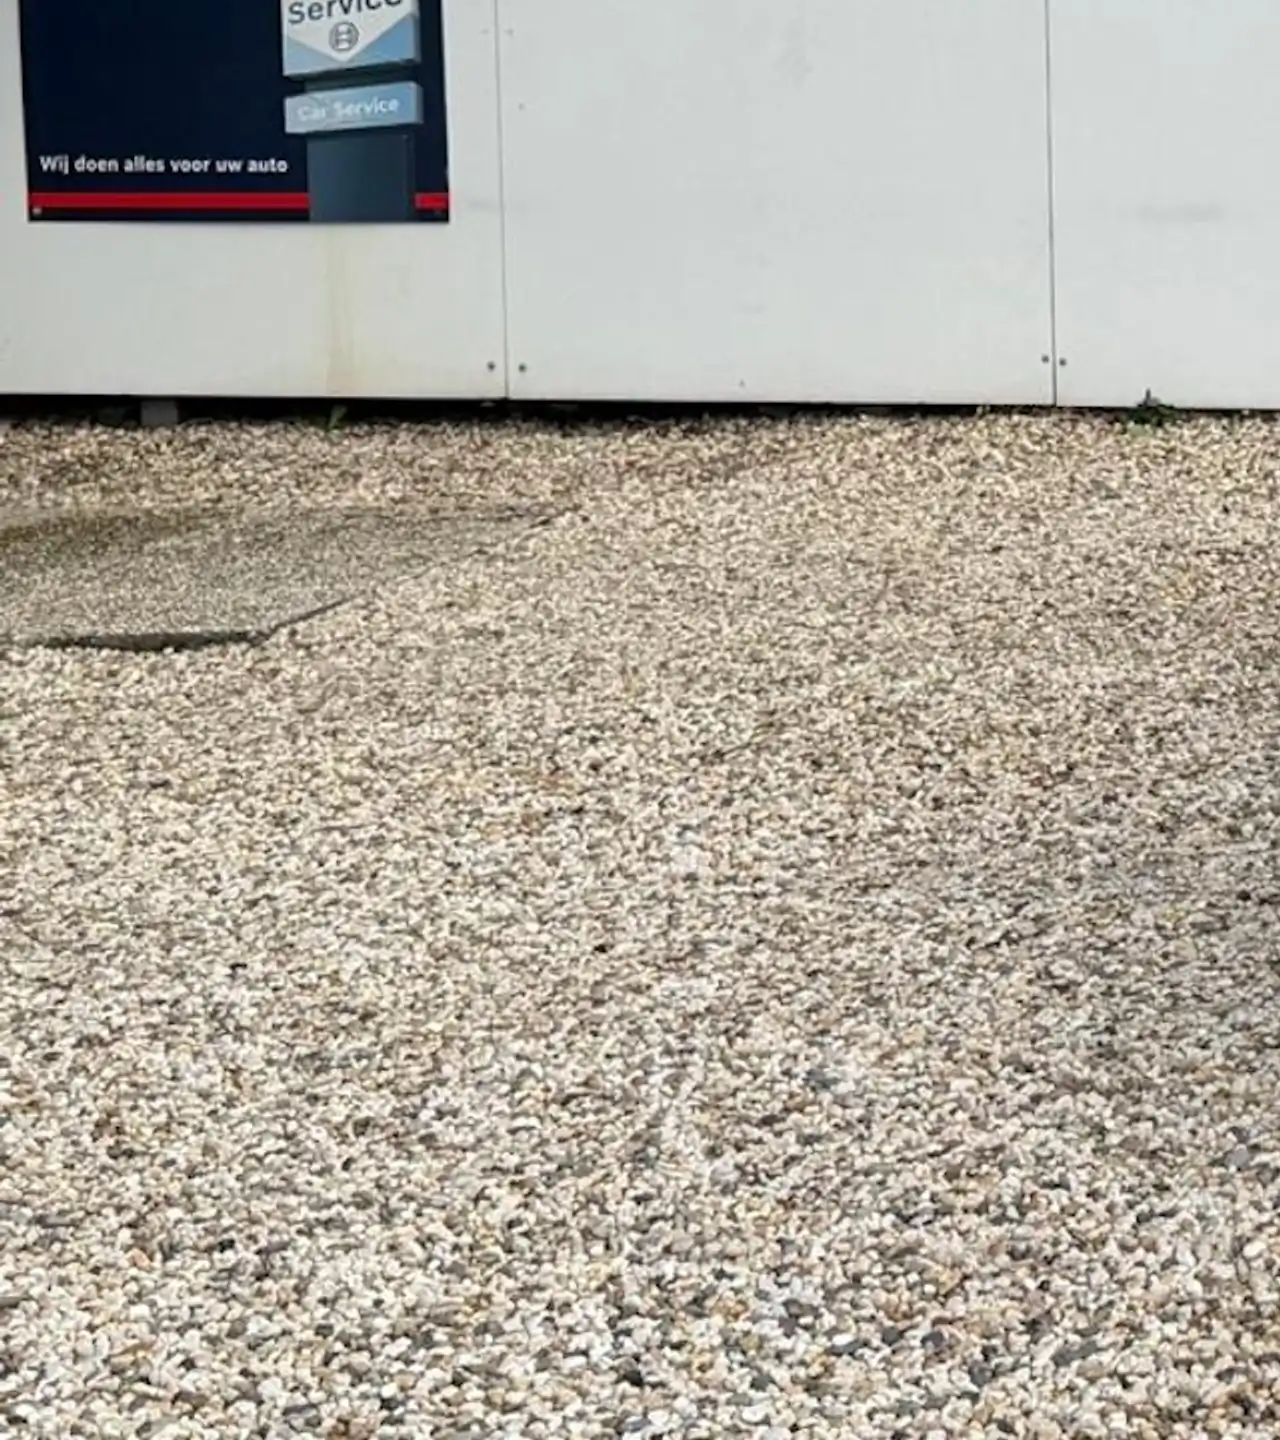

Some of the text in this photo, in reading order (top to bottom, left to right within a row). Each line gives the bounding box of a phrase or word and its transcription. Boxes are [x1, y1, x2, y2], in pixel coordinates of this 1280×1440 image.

[297, 96, 399, 122] Car Service
[40, 156, 289, 175] Wij doen alles voor uw auto
